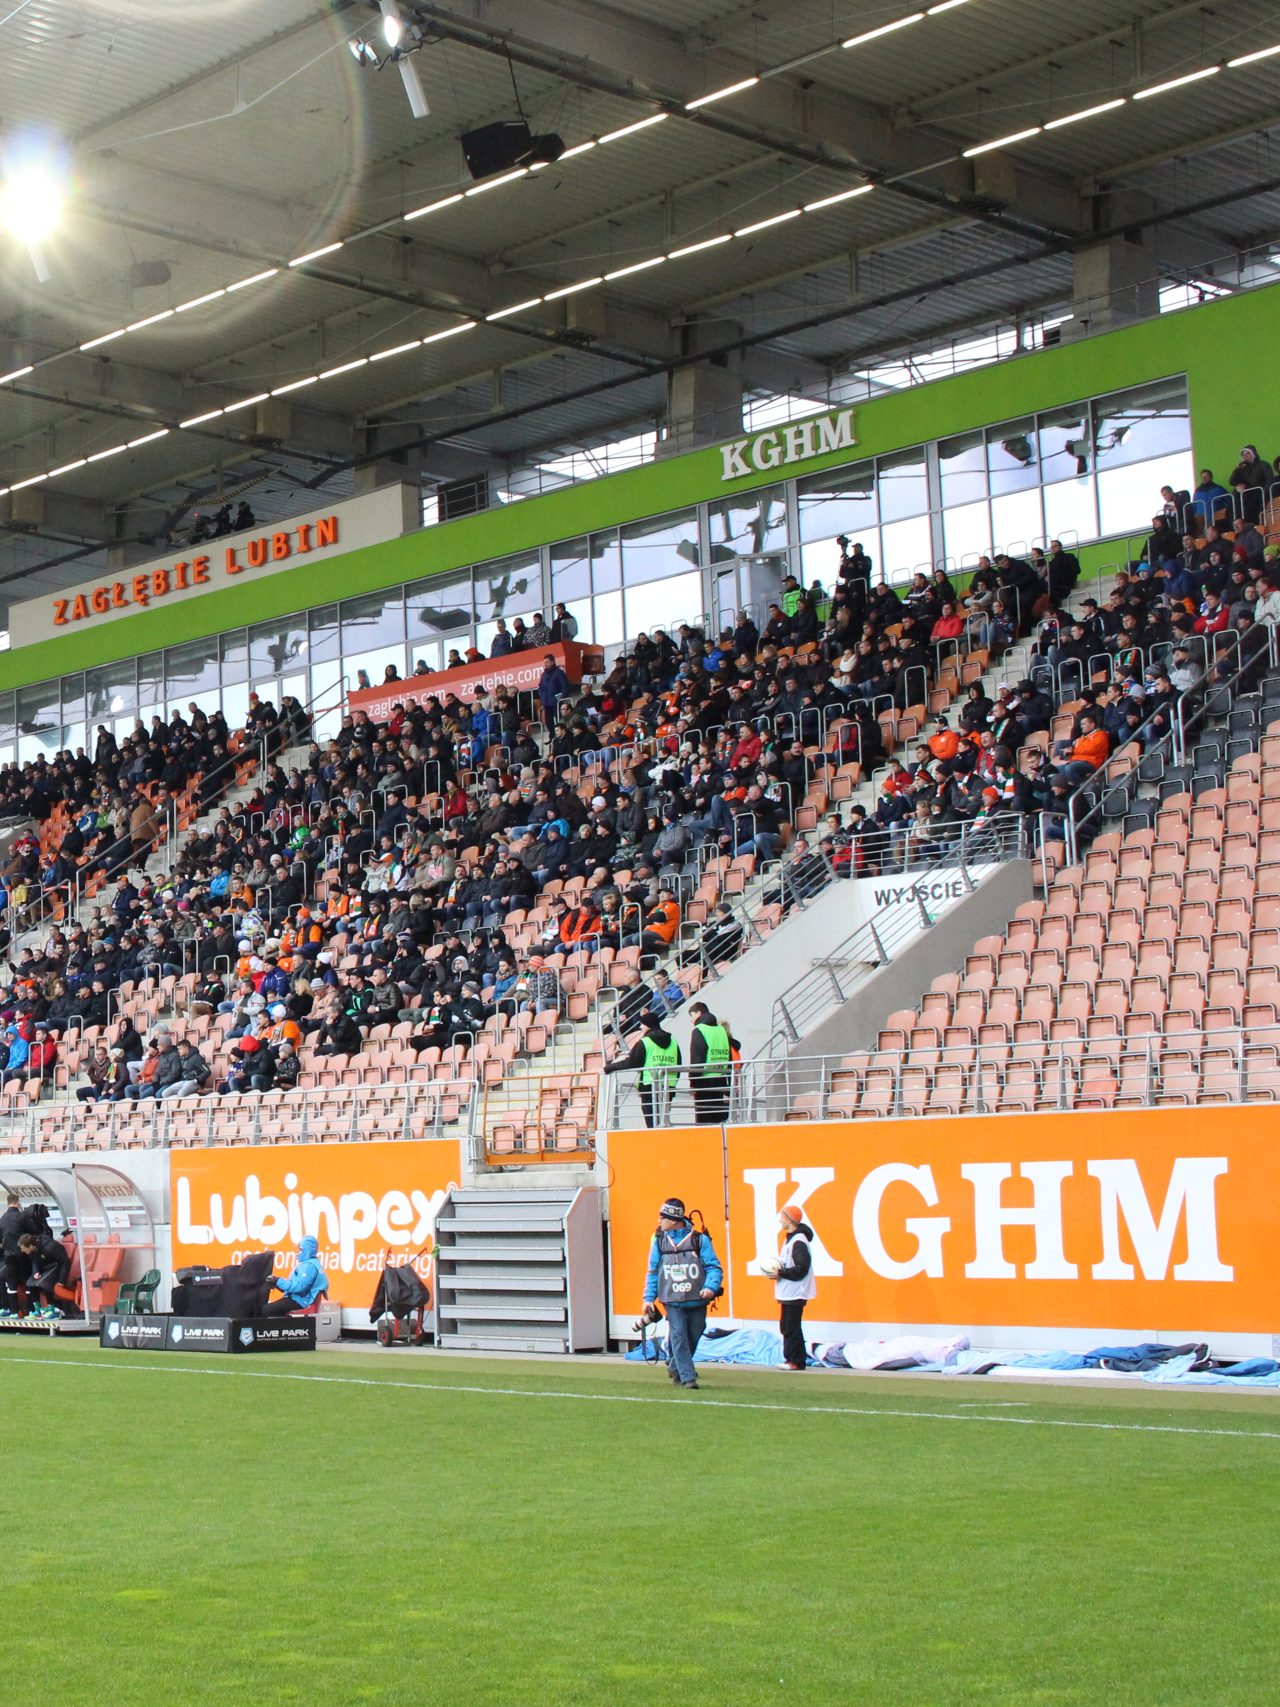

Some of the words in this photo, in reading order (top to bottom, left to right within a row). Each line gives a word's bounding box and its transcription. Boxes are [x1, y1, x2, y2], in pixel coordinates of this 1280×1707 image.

[720, 410, 856, 481] KGHM
[53, 556, 210, 625] ZAGŁĘBIE
[225, 515, 338, 574] LUBIN
[875, 881, 964, 906] WYJŚCIE
[95, 1184, 135, 1197] KGHM
[177, 1172, 447, 1274] Lubinpex
[744, 1156, 1235, 1282] KGHM
[663, 1263, 699, 1281] FOTO
[672, 1282, 692, 1292] 069
[121, 1325, 140, 1334] LIVE
[140, 1326, 162, 1335] PARK
[184, 1328, 201, 1336] LIVE
[201, 1328, 224, 1337] PARK
[256, 1330, 279, 1338] LIVE
[281, 1328, 309, 1337] PARK
